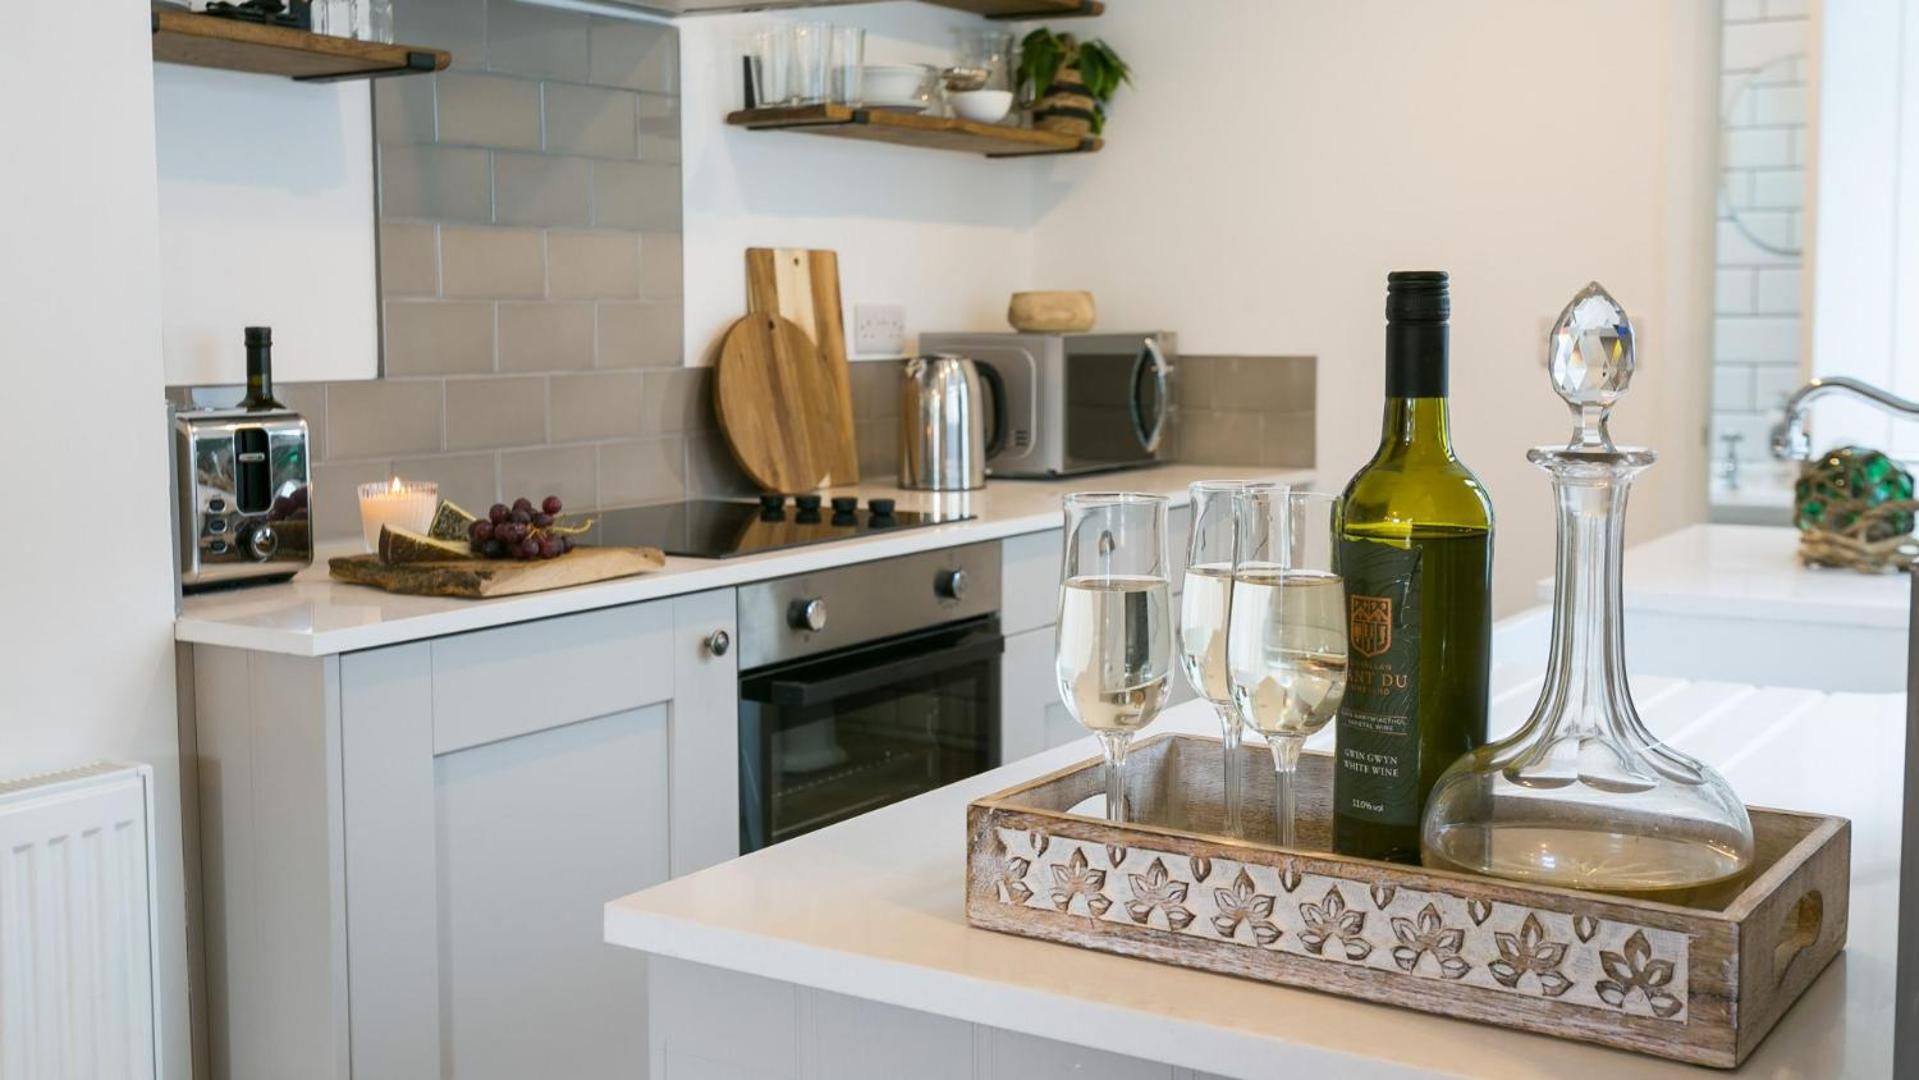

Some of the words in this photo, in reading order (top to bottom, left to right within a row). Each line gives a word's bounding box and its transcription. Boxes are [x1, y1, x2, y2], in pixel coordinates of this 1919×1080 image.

[1382, 673, 1408, 688] DU
[1344, 760, 1369, 774] WHITE
[1371, 766, 1399, 777] WINE
